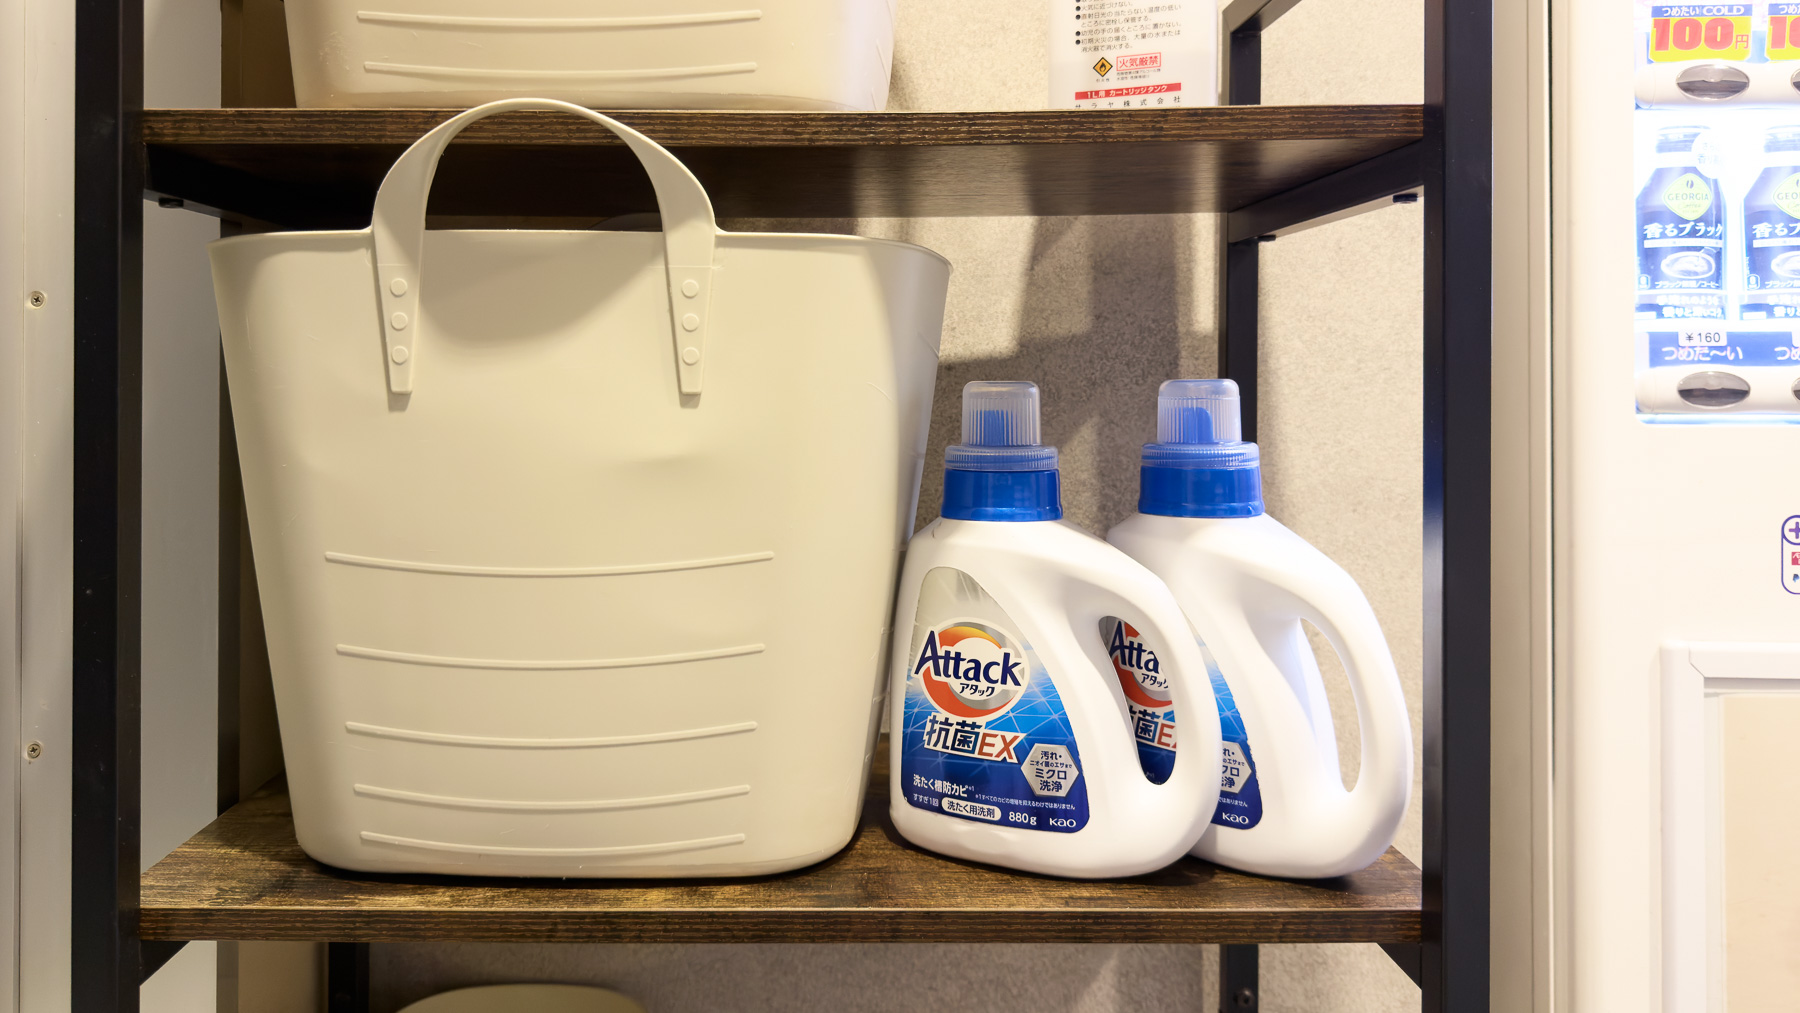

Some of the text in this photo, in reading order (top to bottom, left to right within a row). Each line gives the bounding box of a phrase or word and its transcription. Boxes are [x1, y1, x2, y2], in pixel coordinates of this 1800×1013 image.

[1662, 5, 1745, 16] つめたい COLD
[1119, 56, 1159, 68] 火気厳禁
[1110, 86, 1167, 97] カートリッジタンク
[1667, 192, 1710, 201] GEORGIA
[1776, 191, 1800, 200] GEO
[1643, 221, 1723, 239] 香るブラック
[1109, 620, 1160, 675] Atta
[914, 630, 1022, 687] Attack
[959, 683, 996, 697] アタック
[1129, 705, 1176, 749] 菌E
[925, 714, 1020, 761] 抗菌EX
[1035, 768, 1067, 780] ミクロ
[1040, 779, 1062, 792] 洗浄
[1221, 776, 1236, 788] 浄
[947, 799, 996, 818] 洗たく用洗剤
